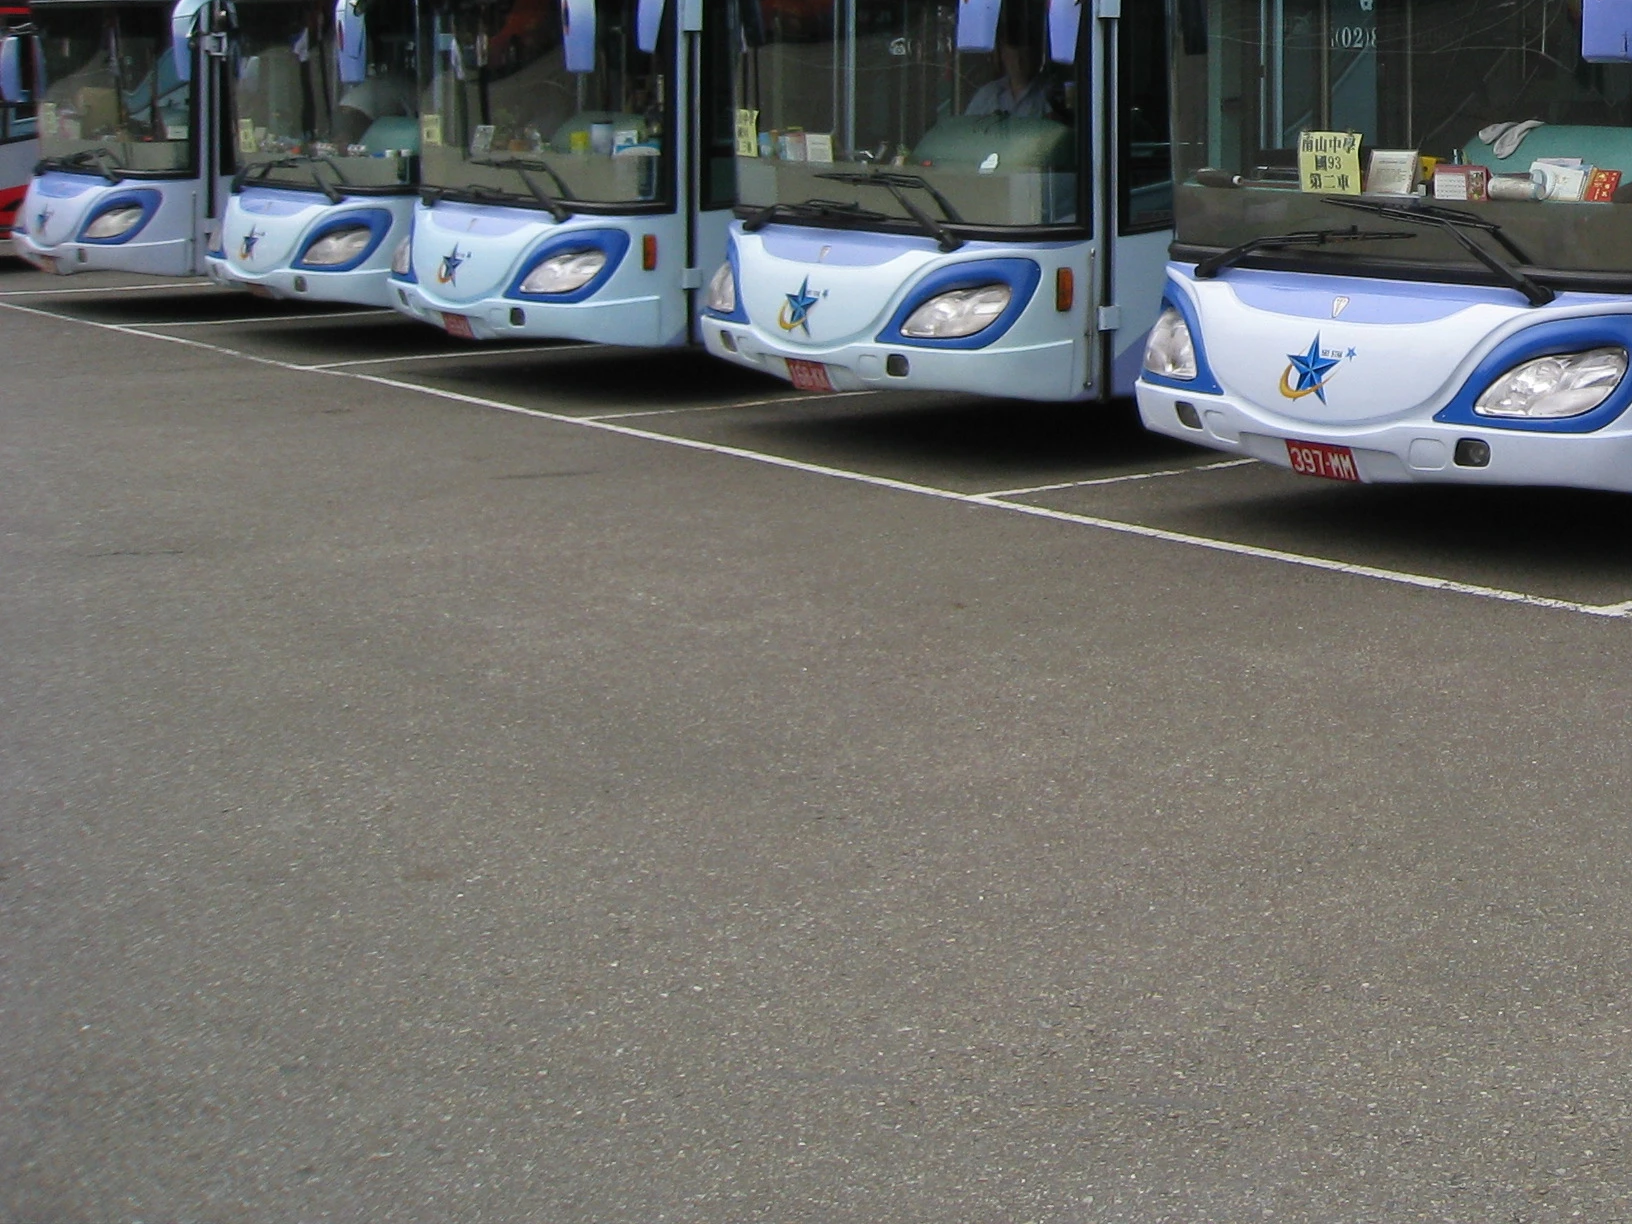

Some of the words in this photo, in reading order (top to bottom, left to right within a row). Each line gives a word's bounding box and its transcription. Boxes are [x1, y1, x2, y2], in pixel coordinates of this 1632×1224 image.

[1309, 173, 1349, 191] 第二車
[1290, 447, 1356, 480] 397-MM
